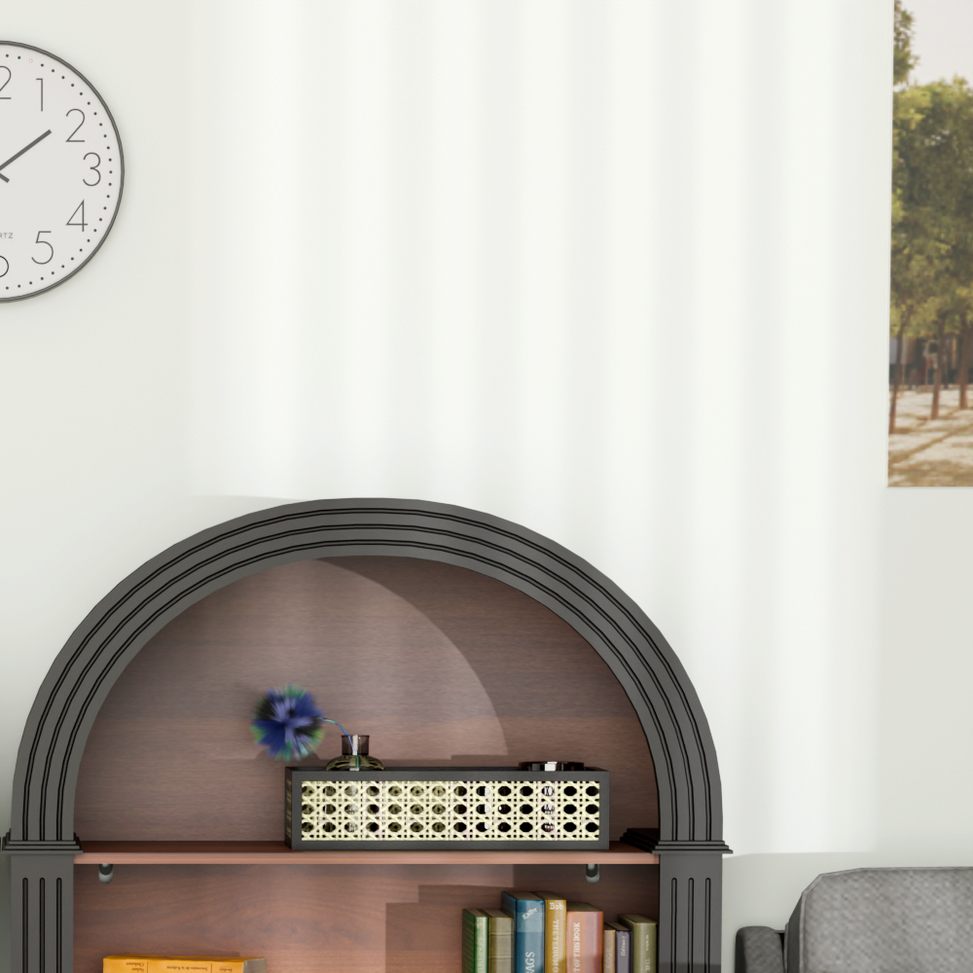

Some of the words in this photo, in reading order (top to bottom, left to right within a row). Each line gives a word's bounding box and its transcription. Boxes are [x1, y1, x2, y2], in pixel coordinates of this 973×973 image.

[35, 77, 43, 112] 1
[65, 108, 86, 143] 2
[82, 152, 102, 187] 3
[65, 199, 89, 233] 4
[31, 230, 55, 265] 5
